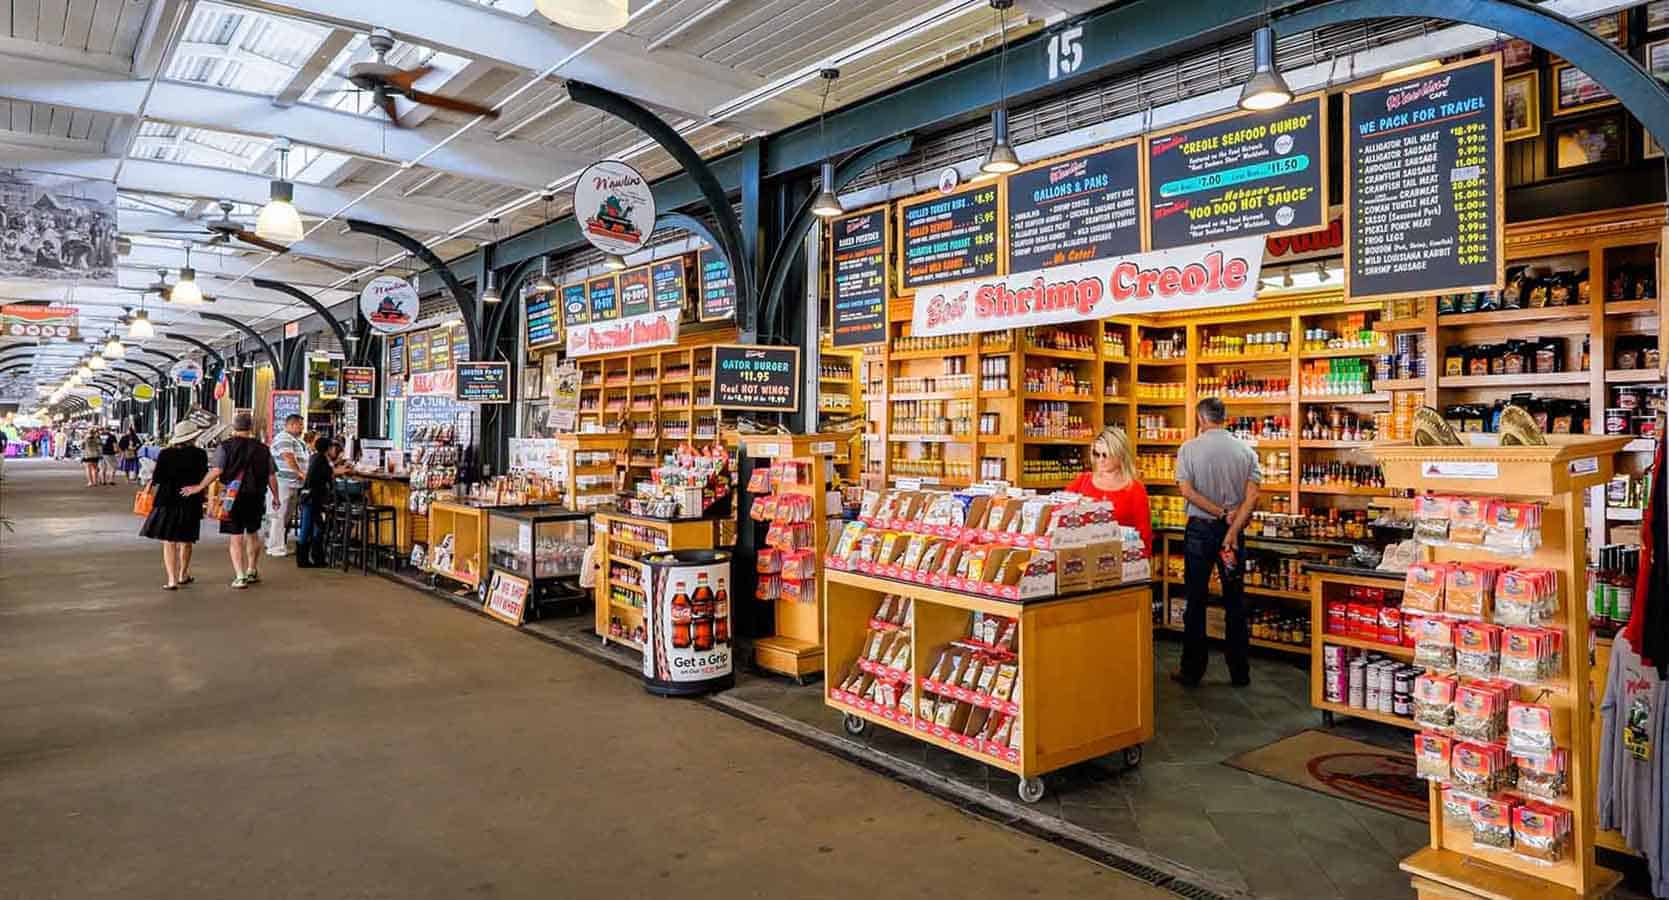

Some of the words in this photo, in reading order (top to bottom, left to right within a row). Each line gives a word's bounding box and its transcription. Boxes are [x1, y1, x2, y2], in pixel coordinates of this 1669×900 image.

[1048, 27, 1082, 80] 15
[1360, 122, 1375, 134] WE
[1380, 113, 1408, 129] PACK
[1413, 107, 1436, 122] FOR
[1440, 97, 1485, 116] TRAVEL
[1222, 126, 1265, 145] SEAFOOD
[1364, 140, 1400, 154] ALLIGATOR
[1420, 131, 1439, 146] MEAT
[1364, 151, 1400, 164] ALLIGATOR
[1403, 143, 1437, 157] SAUSAGE
[1403, 154, 1437, 166] SAUSAGE
[1403, 164, 1436, 177] SAUSAGE
[1034, 184, 1072, 202] GALLONS
[1074, 182, 1082, 192] &
[1084, 174, 1109, 190] PANS
[1419, 174, 1438, 186] MEAT
[1214, 202, 1236, 217] DOO
[1240, 197, 1262, 210] HOT
[1412, 217, 1432, 228] MEAT
[1383, 251, 1421, 263] LOUISIANA
[975, 276, 1104, 317] Shrimp
[1110, 252, 1250, 302] Creole
[722, 359, 750, 370] GATOR
[754, 361, 789, 372] BURGER
[720, 384, 738, 393] Real
[742, 384, 758, 394] HOT
[761, 385, 790, 396] WINGS
[674, 656, 696, 668] Get
[698, 657, 706, 666] a
[708, 652, 728, 666] Grip
